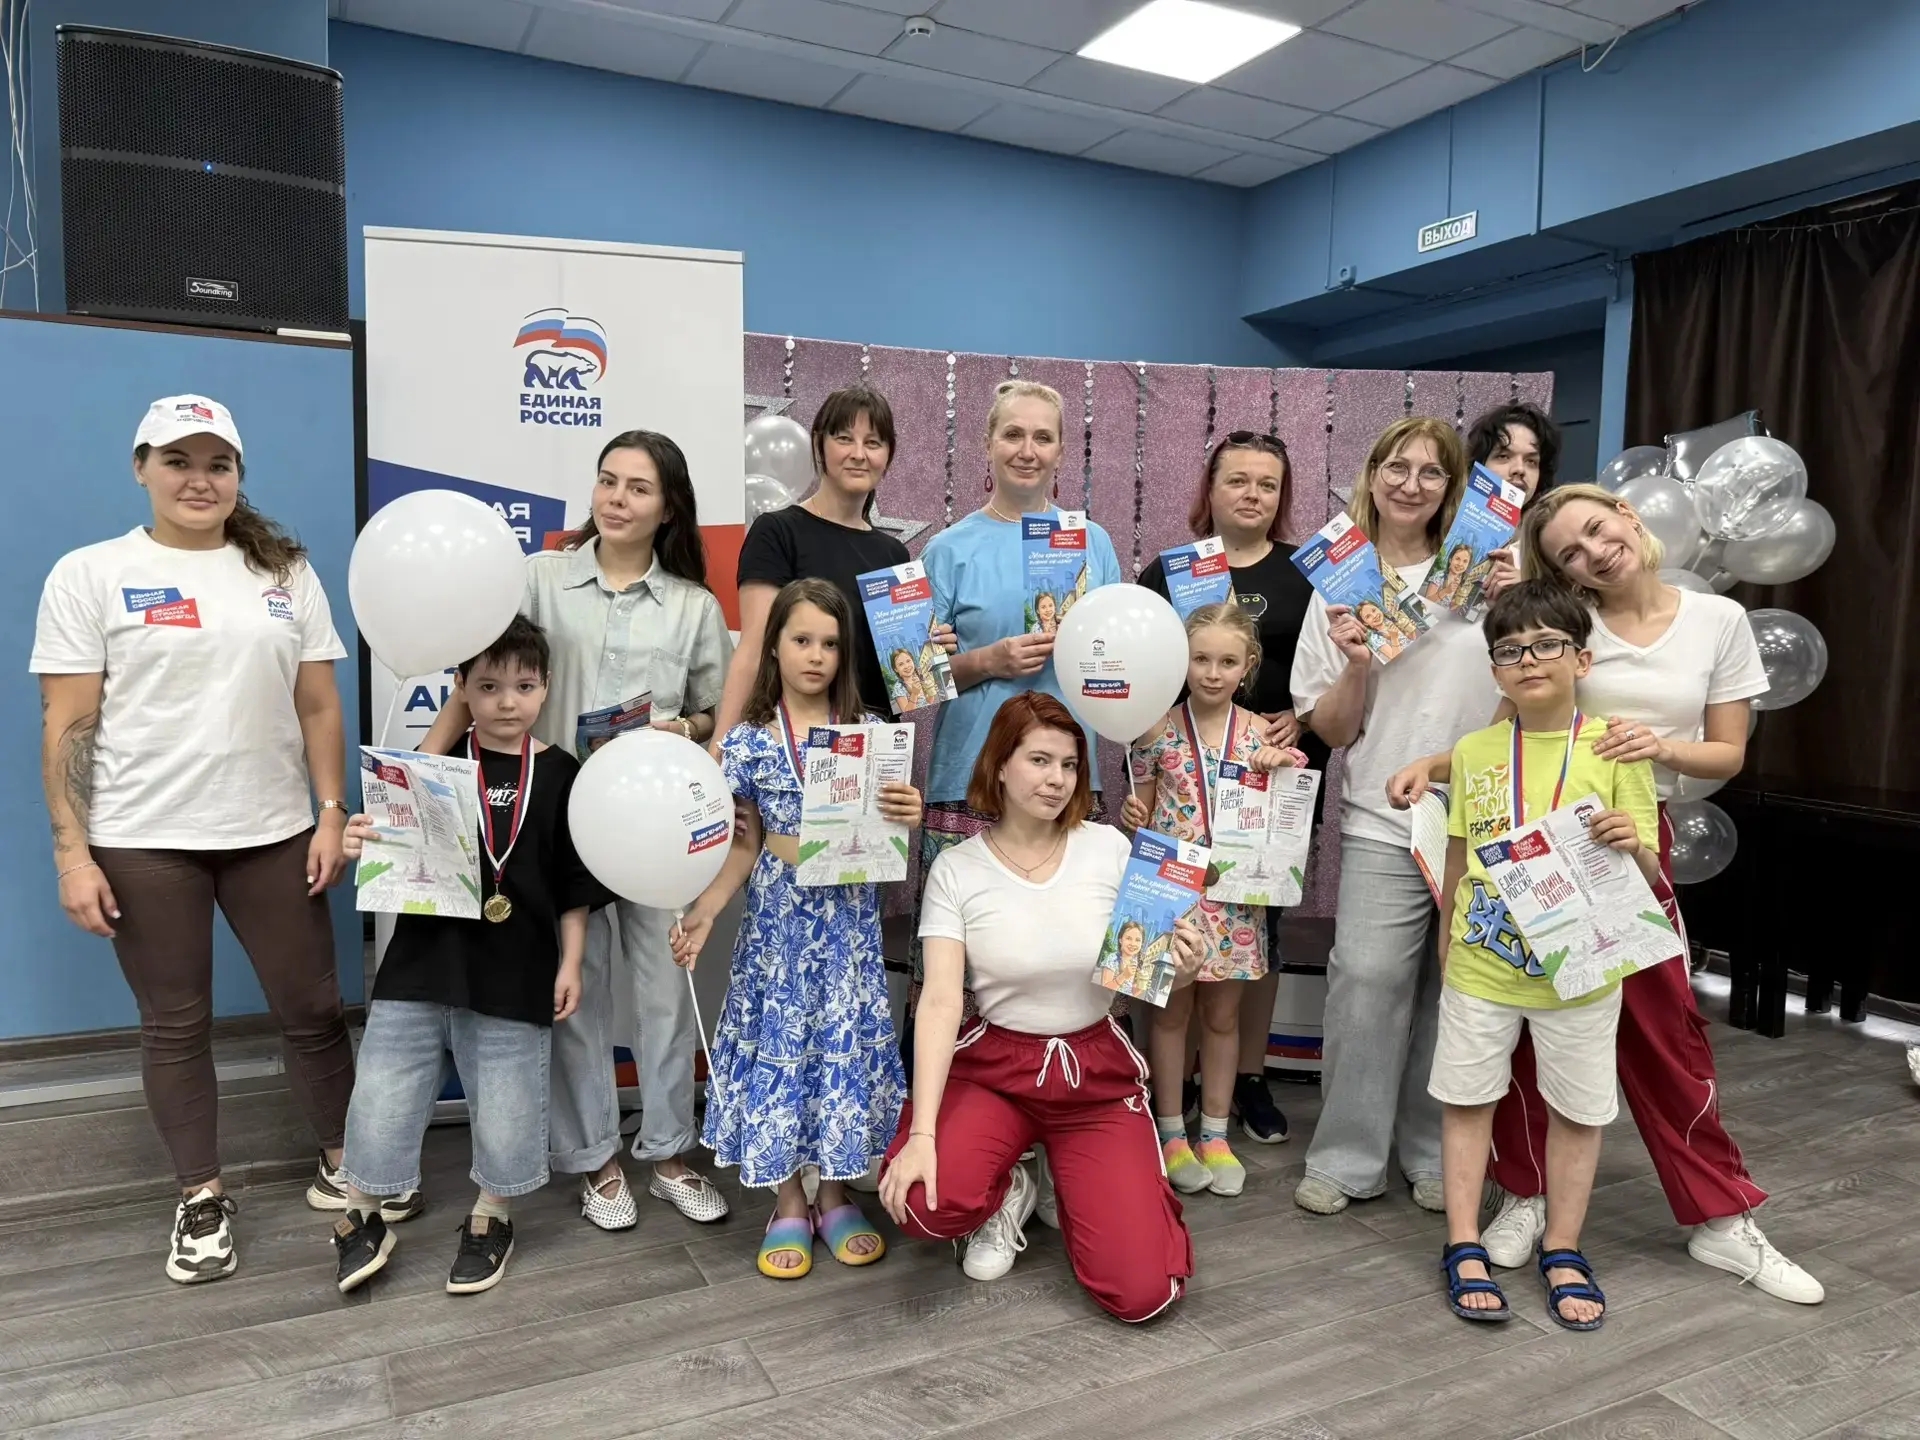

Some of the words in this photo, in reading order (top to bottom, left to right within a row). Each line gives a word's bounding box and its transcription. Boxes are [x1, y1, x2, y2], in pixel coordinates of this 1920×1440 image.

[1425, 217, 1472, 246] ВЫХОД
[190, 282, 232, 298] Soundking
[520, 394, 602, 410] ЕДИНАЯ
[520, 410, 602, 427] РОССИЯ
[130, 590, 164, 599] ЕДИНАЯ
[131, 595, 166, 604] РОССИЯ
[132, 600, 165, 609] СЕЙЧАС
[151, 605, 189, 614] ВЕЛИКАЯ
[810, 755, 838, 774] ЕДИНАЯ
[810, 767, 837, 785] РОССИЯ
[830, 774, 858, 792] РОДИНА
[364, 781, 387, 793] ЕДИНАЯ
[1221, 787, 1244, 800] ЕДИНАЯ
[366, 793, 390, 805] РОССИЯ
[830, 787, 861, 805] ТАЛАНТОВ
[386, 802, 414, 817] РОДИНА
[1221, 798, 1244, 811] РОССИЯ
[1238, 806, 1262, 820] РОДИНА
[389, 815, 420, 828] ТАЛАНТОВ
[1238, 818, 1265, 830] ТАЛАНТОВ
[1140, 846, 1165, 856] РОССИЯ
[1142, 841, 1166, 852] ЕДИНАЯ
[1498, 862, 1528, 890] ЕДИНАЯ
[1505, 875, 1534, 901] РОССИЯ
[1531, 870, 1566, 900] РОДИНА
[1538, 881, 1576, 912] ТАЛАНТОВ
